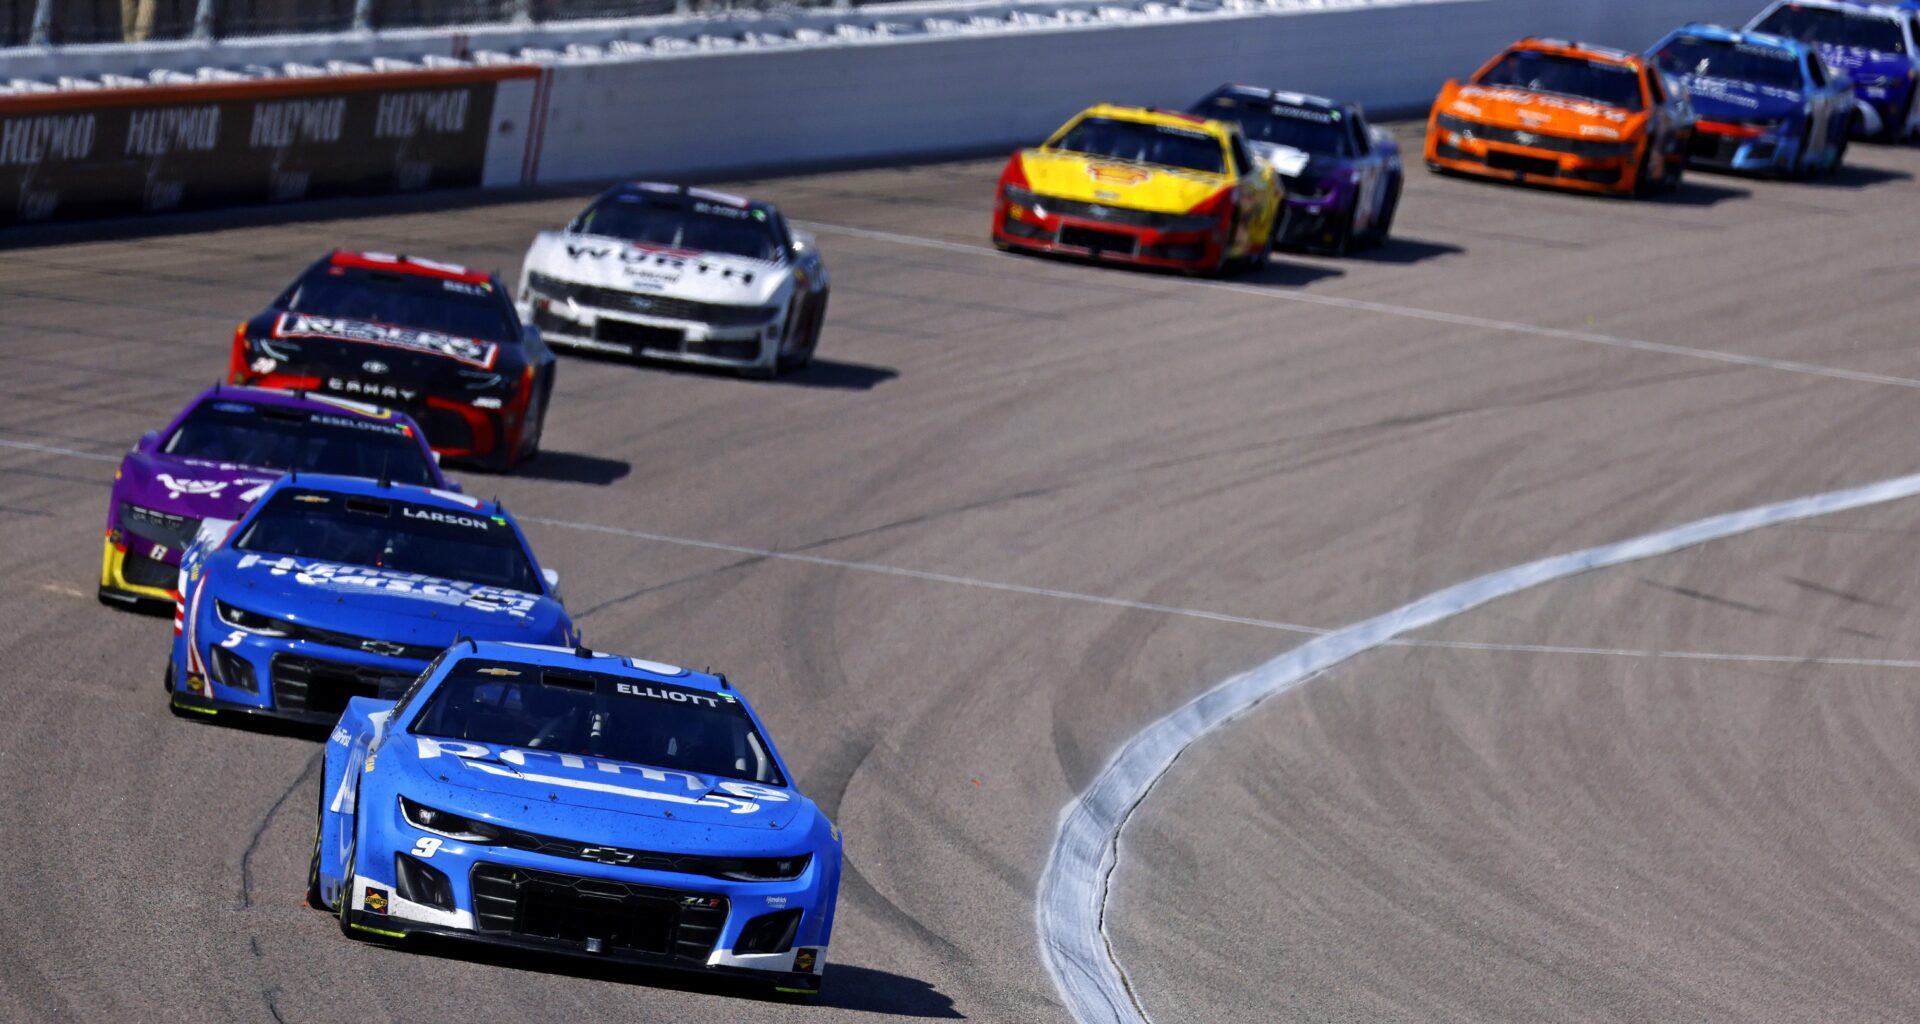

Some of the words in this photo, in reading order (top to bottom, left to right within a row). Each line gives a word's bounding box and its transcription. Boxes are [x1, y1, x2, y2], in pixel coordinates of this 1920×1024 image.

[403, 508, 488, 530] LARSON
[221, 630, 248, 648] 5
[616, 682, 719, 708] ELLIOTT
[410, 836, 443, 858] 9
